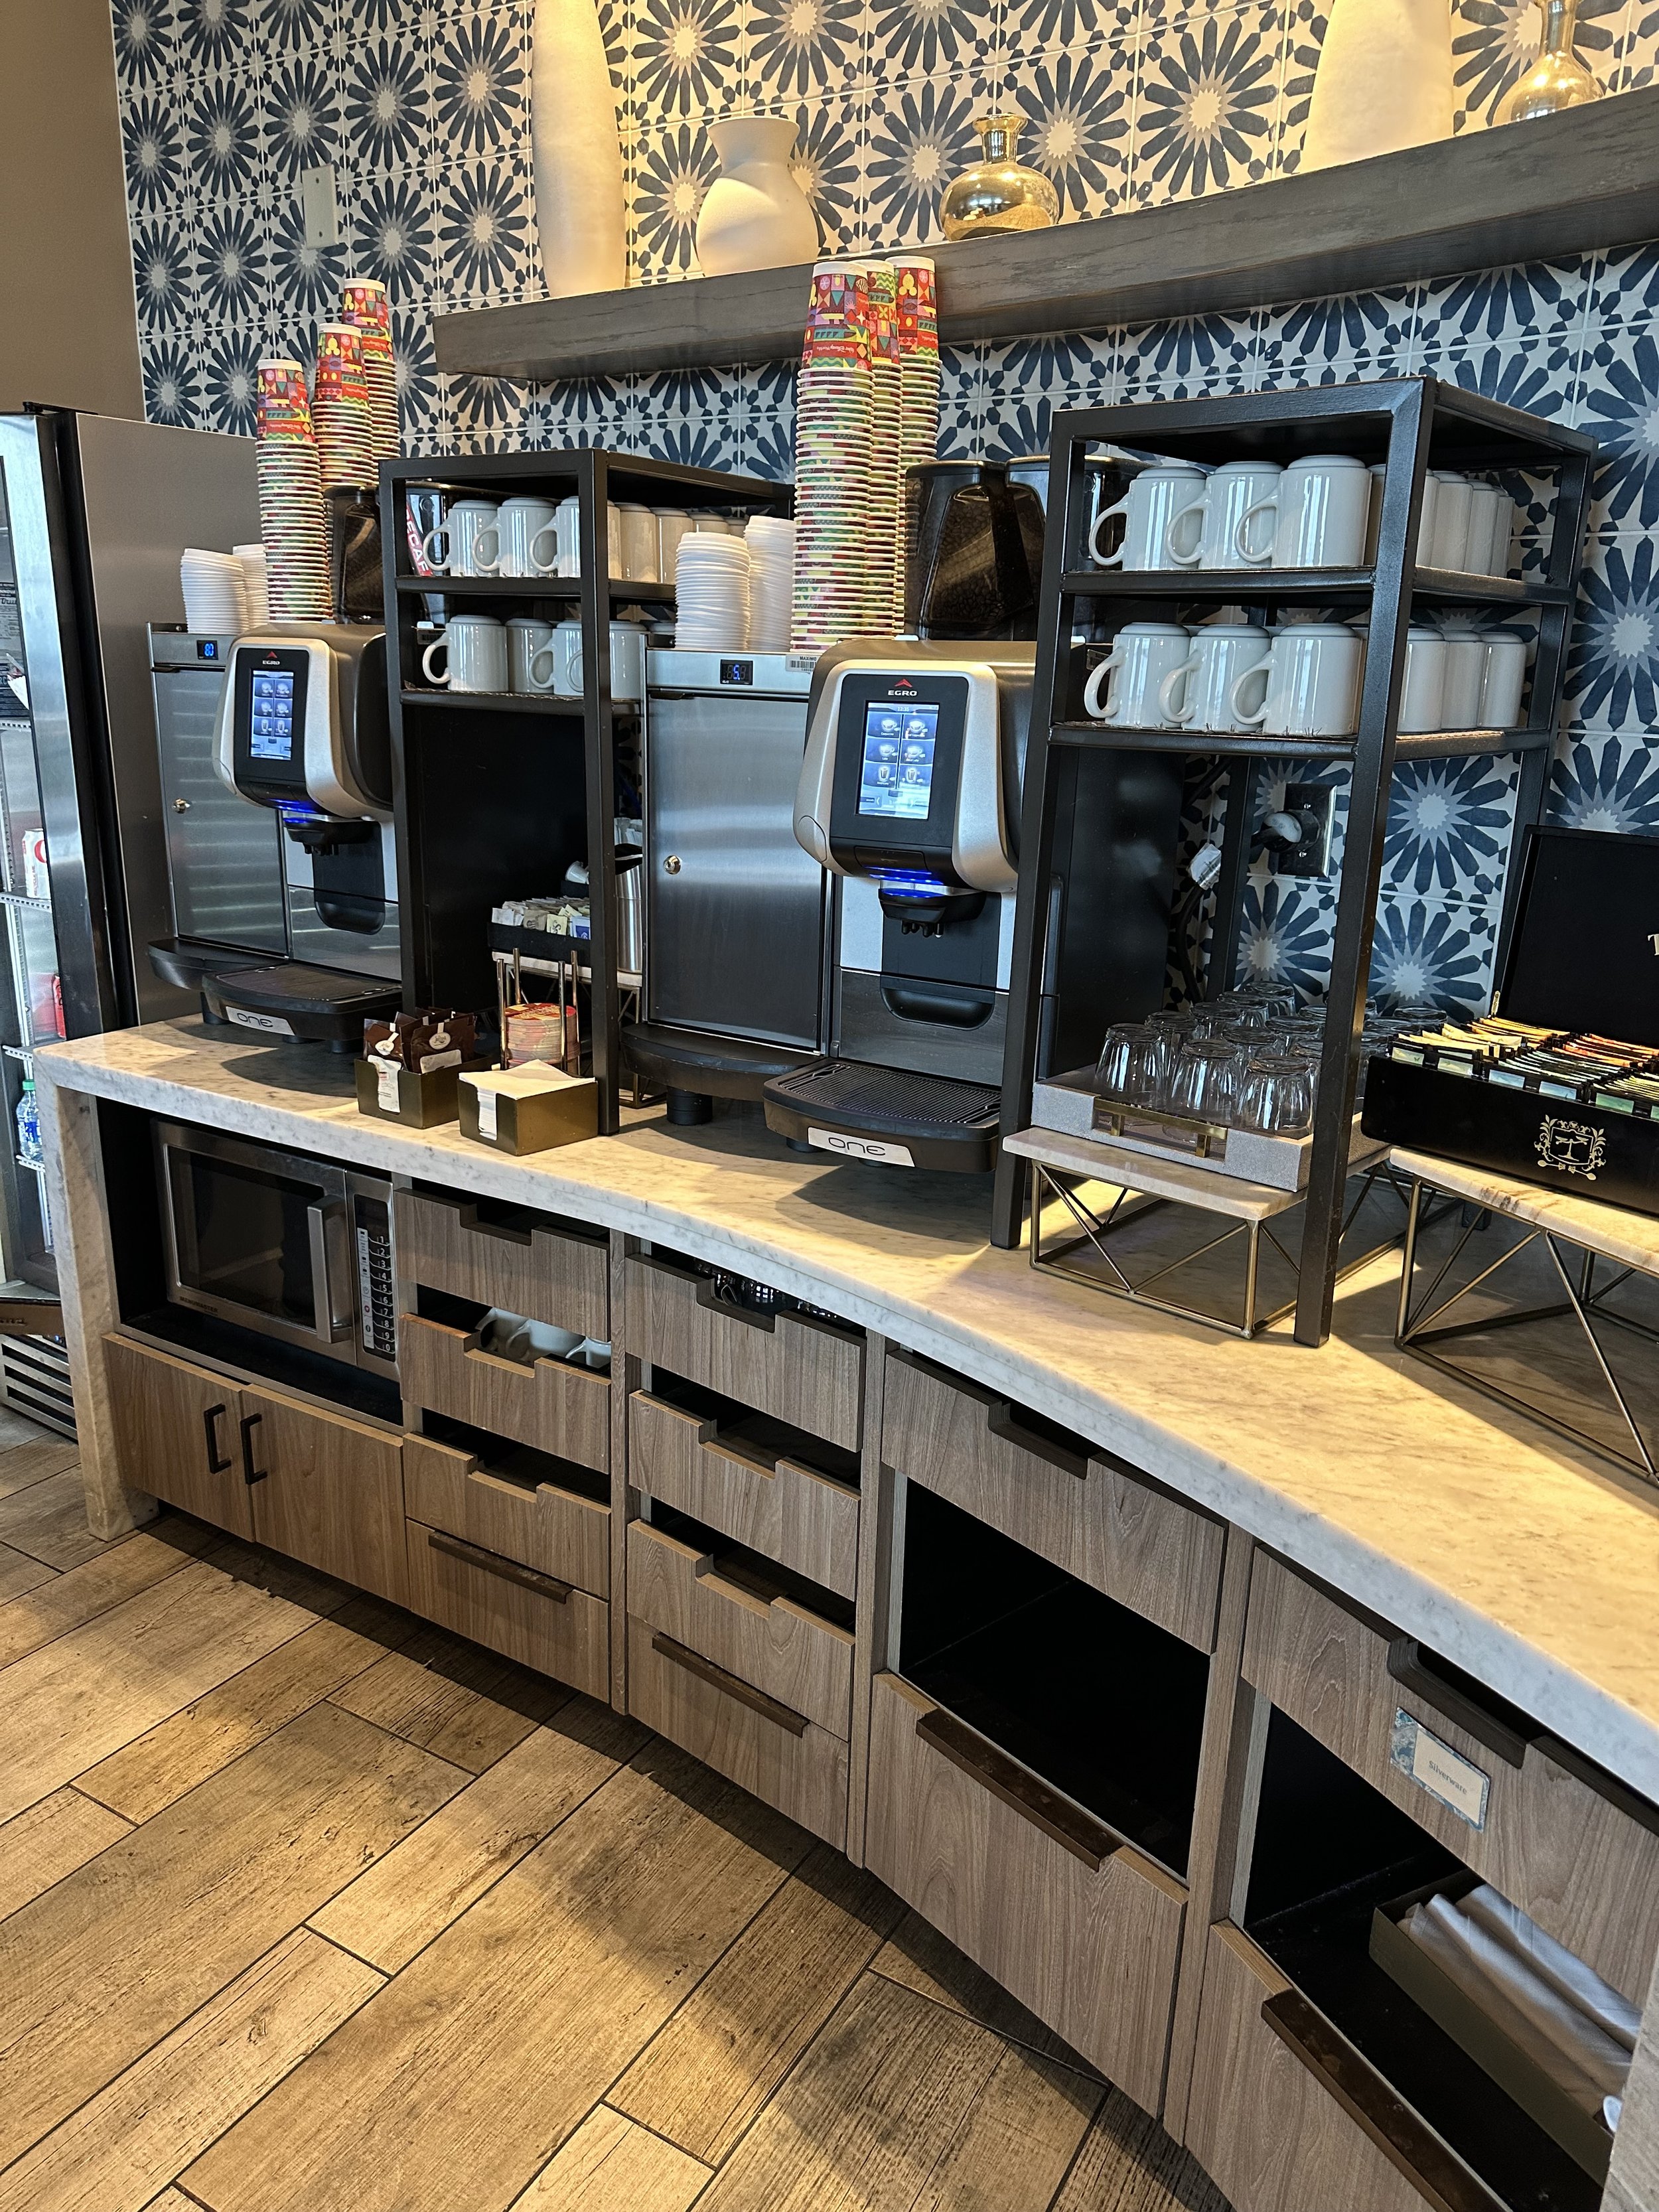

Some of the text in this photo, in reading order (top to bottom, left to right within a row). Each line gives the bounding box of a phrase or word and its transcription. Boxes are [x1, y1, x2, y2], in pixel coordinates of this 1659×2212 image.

[380, 1248, 386, 1256] 2
[381, 1260, 386, 1268] 3
[180, 1295, 218, 1313] MENUMASTER
[1429, 1760, 1467, 1795] Silverware
